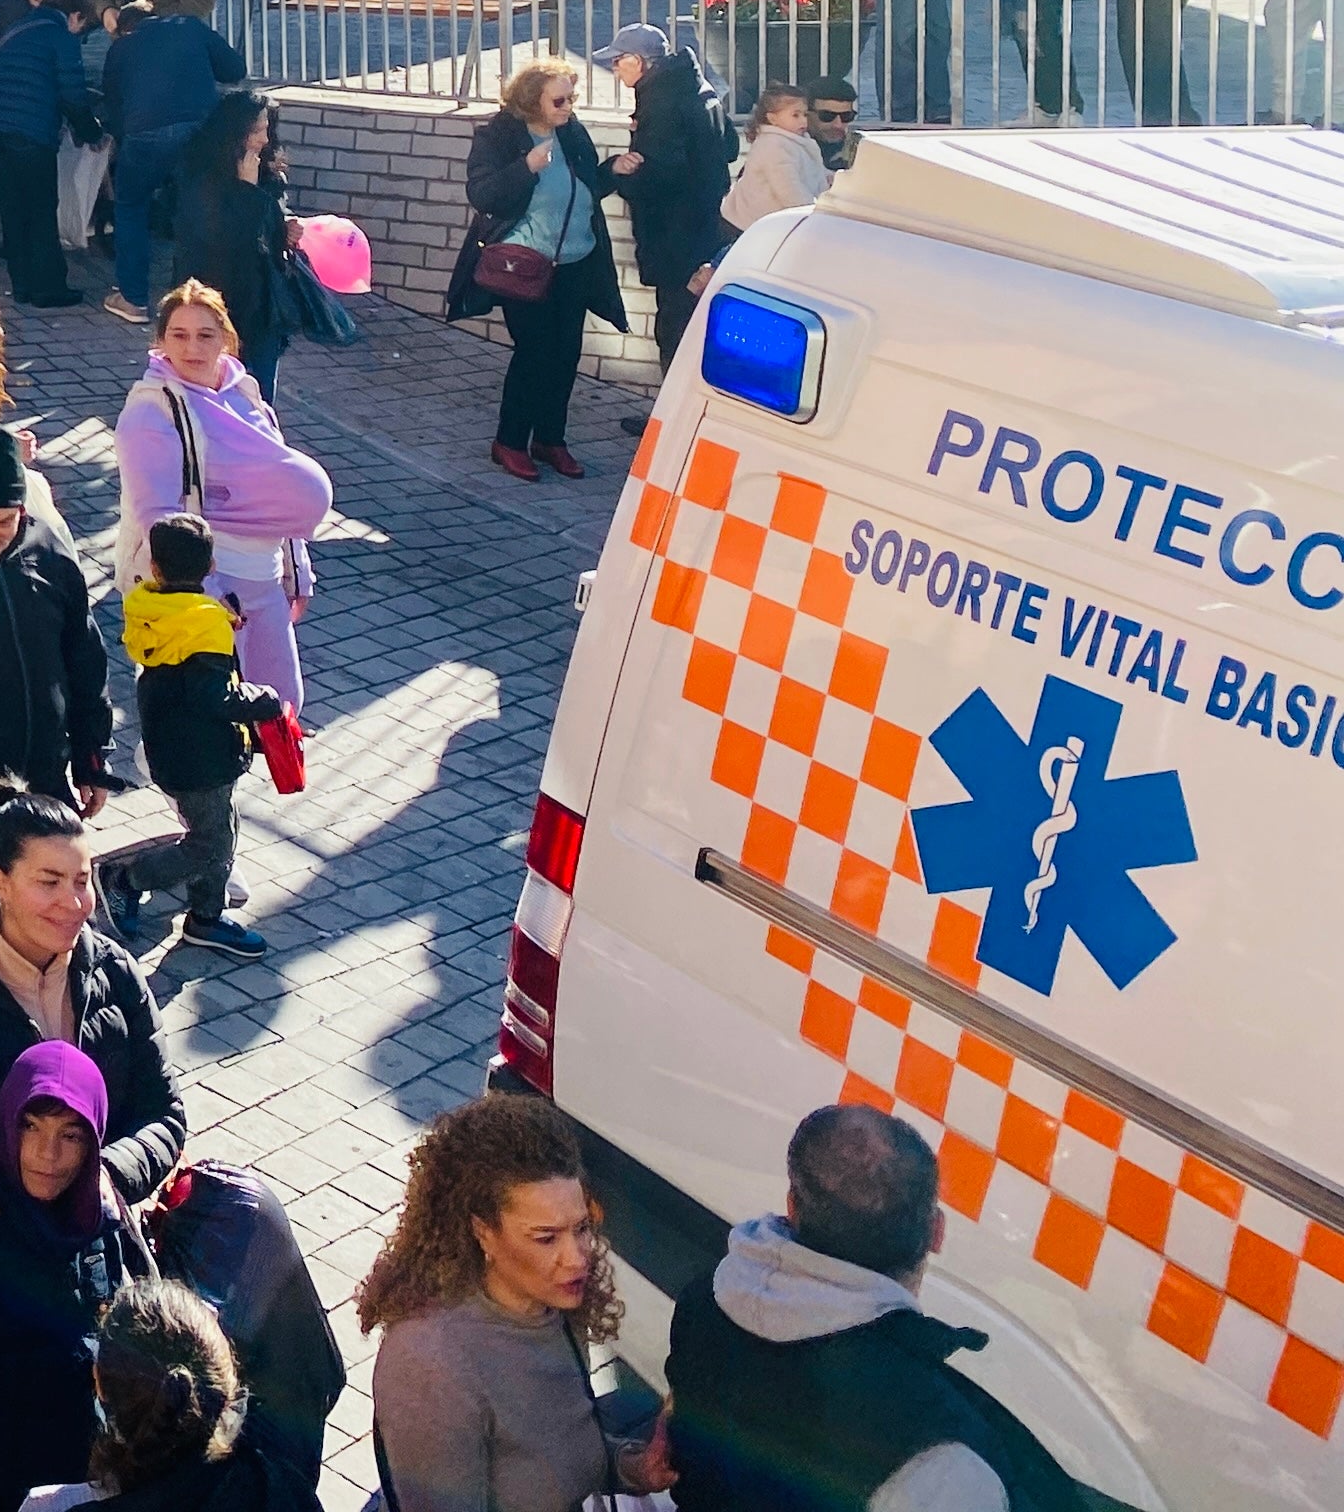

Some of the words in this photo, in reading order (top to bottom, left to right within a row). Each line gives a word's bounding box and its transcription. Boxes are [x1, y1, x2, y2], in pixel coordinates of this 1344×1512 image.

[926, 409, 1344, 610] PROTECC
[844, 519, 1051, 646] SOPORTE
[1060, 597, 1192, 706] VITAL
